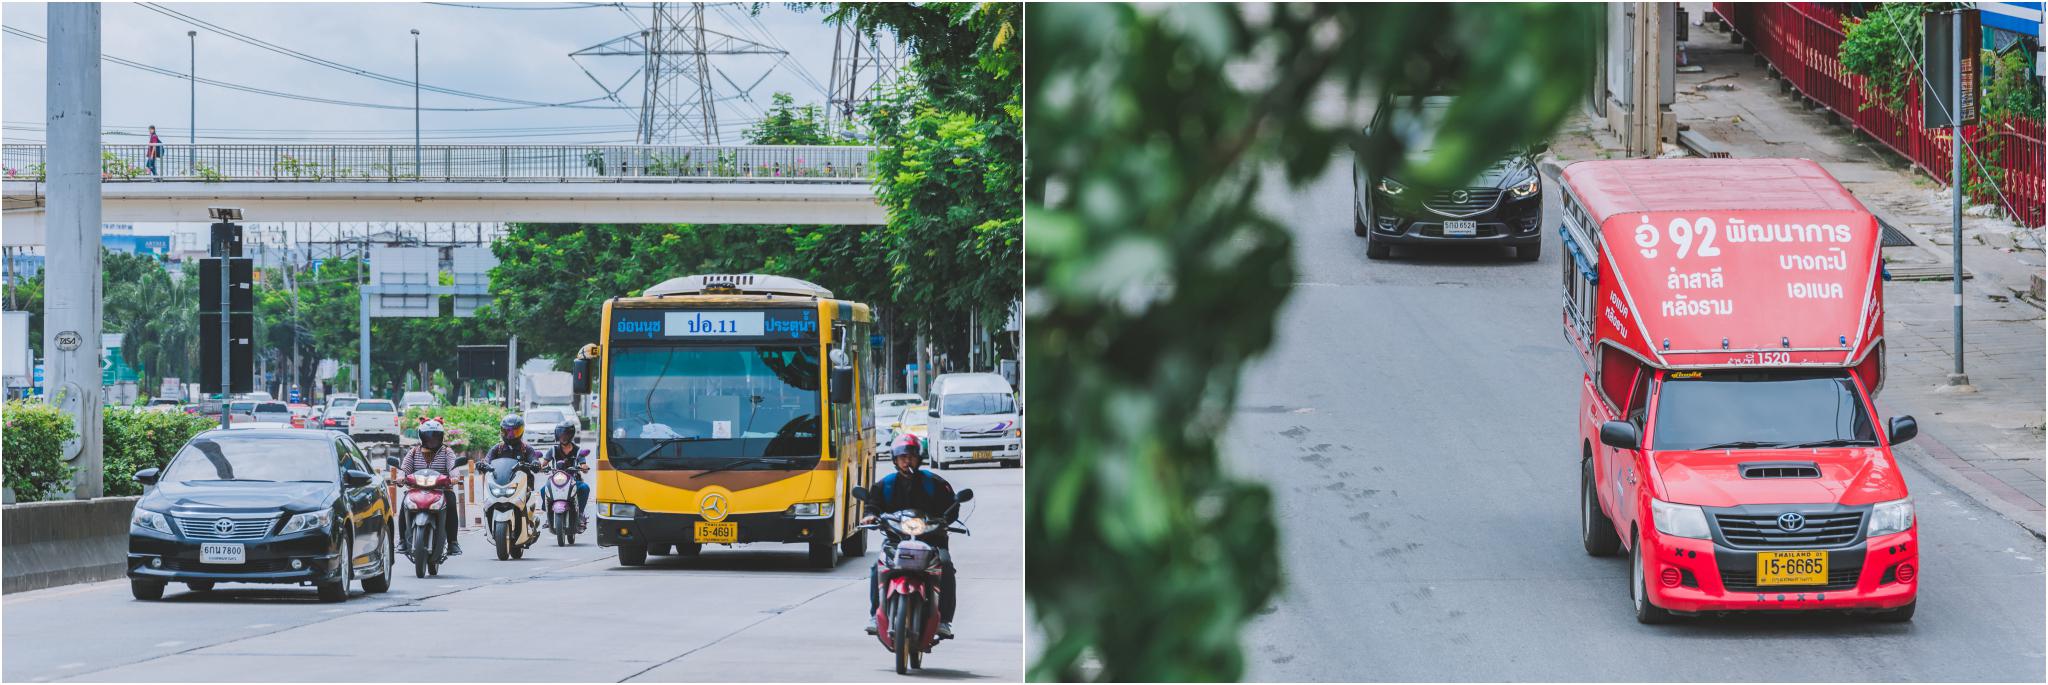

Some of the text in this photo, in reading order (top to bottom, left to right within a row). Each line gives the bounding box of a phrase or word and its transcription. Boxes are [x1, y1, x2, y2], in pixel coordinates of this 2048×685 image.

[1634, 214, 1852, 260] อู่ 92 พัฒนาการ
[1779, 247, 1847, 271] บางกะปิ
[1667, 266, 1724, 290] ลำสาลี
[1787, 282, 1844, 299] เอแบค
[1661, 293, 1733, 318] หลังราม
[617, 310, 816, 338] อ่อนนุช ปอ.11 ประตูน้ำ
[1757, 351, 1791, 365] 1520
[698, 526, 733, 537] 15-4691
[222, 546, 242, 555] 7800
[1764, 558, 1823, 575] 15-6665
